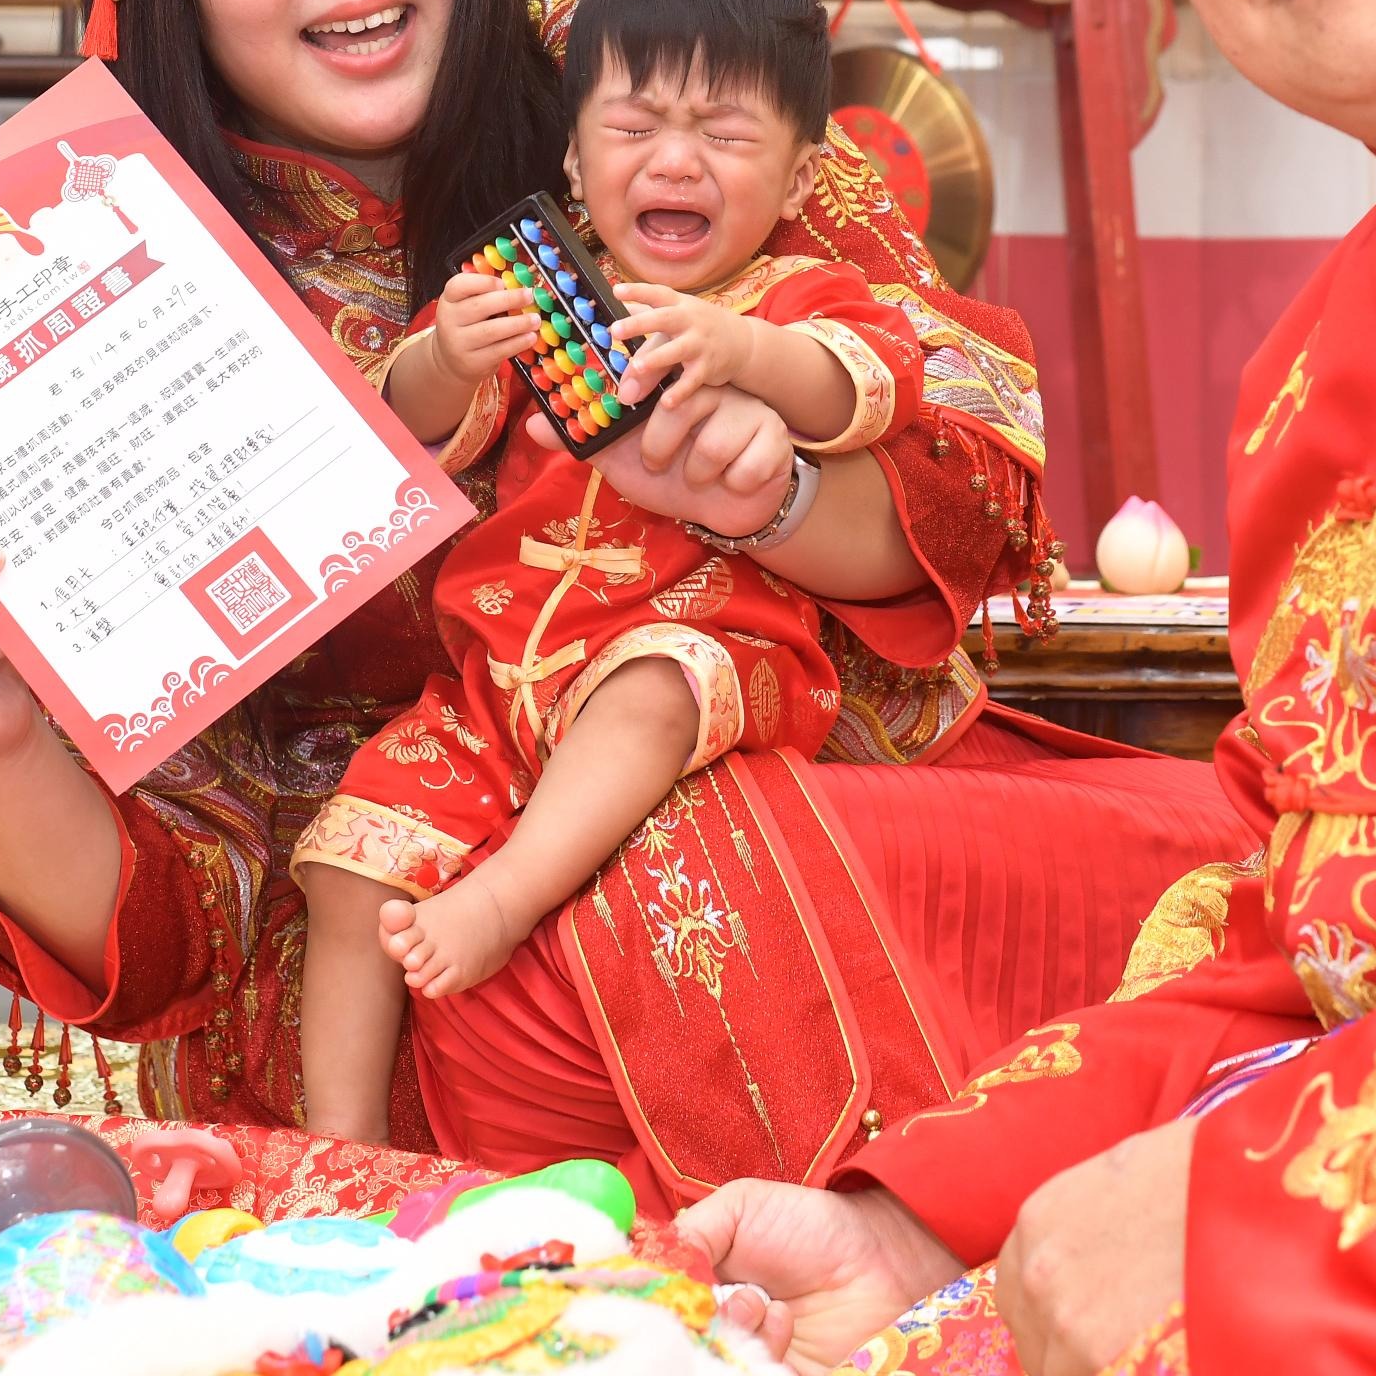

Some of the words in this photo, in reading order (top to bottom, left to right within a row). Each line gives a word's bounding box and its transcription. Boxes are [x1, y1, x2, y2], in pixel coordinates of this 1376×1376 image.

[117, 327, 134, 344] 年
[131, 313, 149, 330] 6
[149, 303, 166, 320] 月
[165, 286, 185, 307] 29
[181, 279, 198, 295] 日
[53, 562, 95, 600] 信用卡
